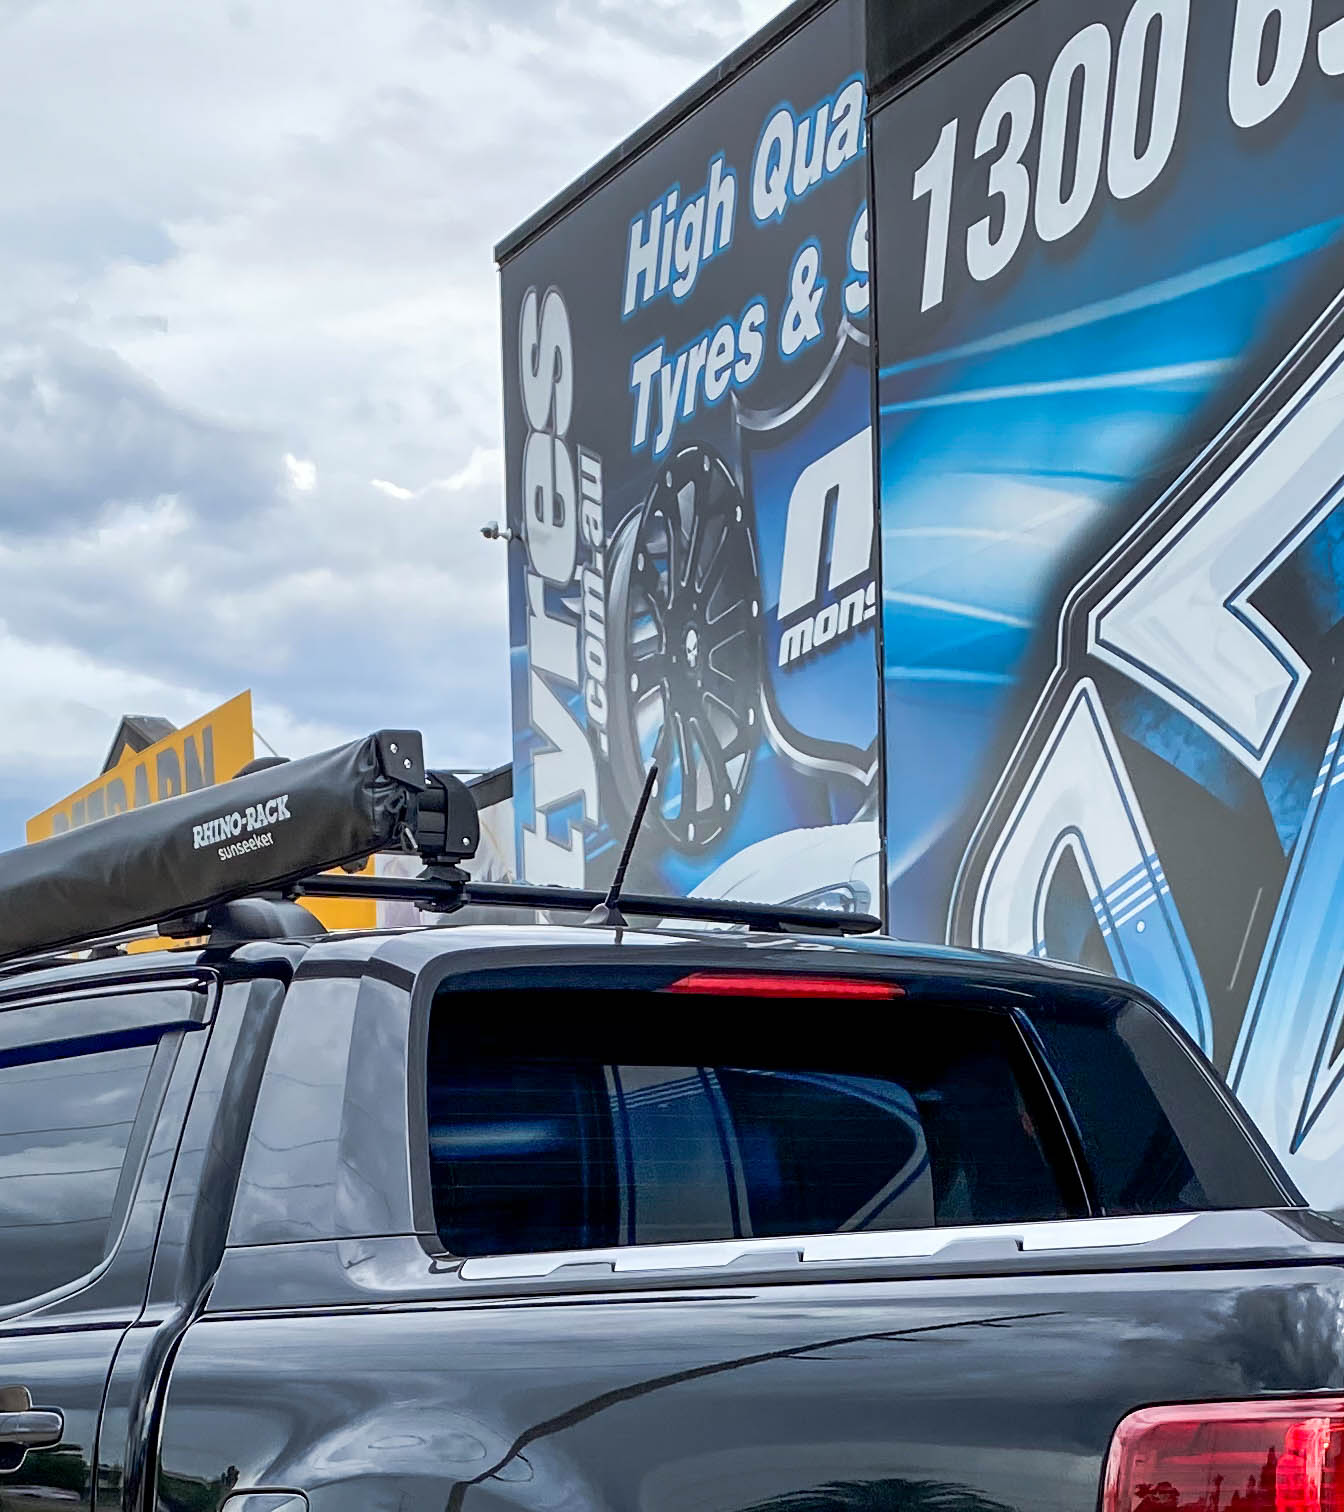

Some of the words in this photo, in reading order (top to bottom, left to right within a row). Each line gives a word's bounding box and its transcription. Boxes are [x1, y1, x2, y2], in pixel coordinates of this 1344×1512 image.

[623, 157, 735, 316] High
[752, 80, 868, 221] Qua
[913, 0, 1190, 312] 1300
[631, 303, 766, 455] Tyres
[780, 245, 824, 355] &
[519, 285, 600, 889] tyres
[577, 444, 610, 756] .com.au
[192, 794, 292, 850] RHINO-RACK
[217, 831, 275, 861] sunseeker
